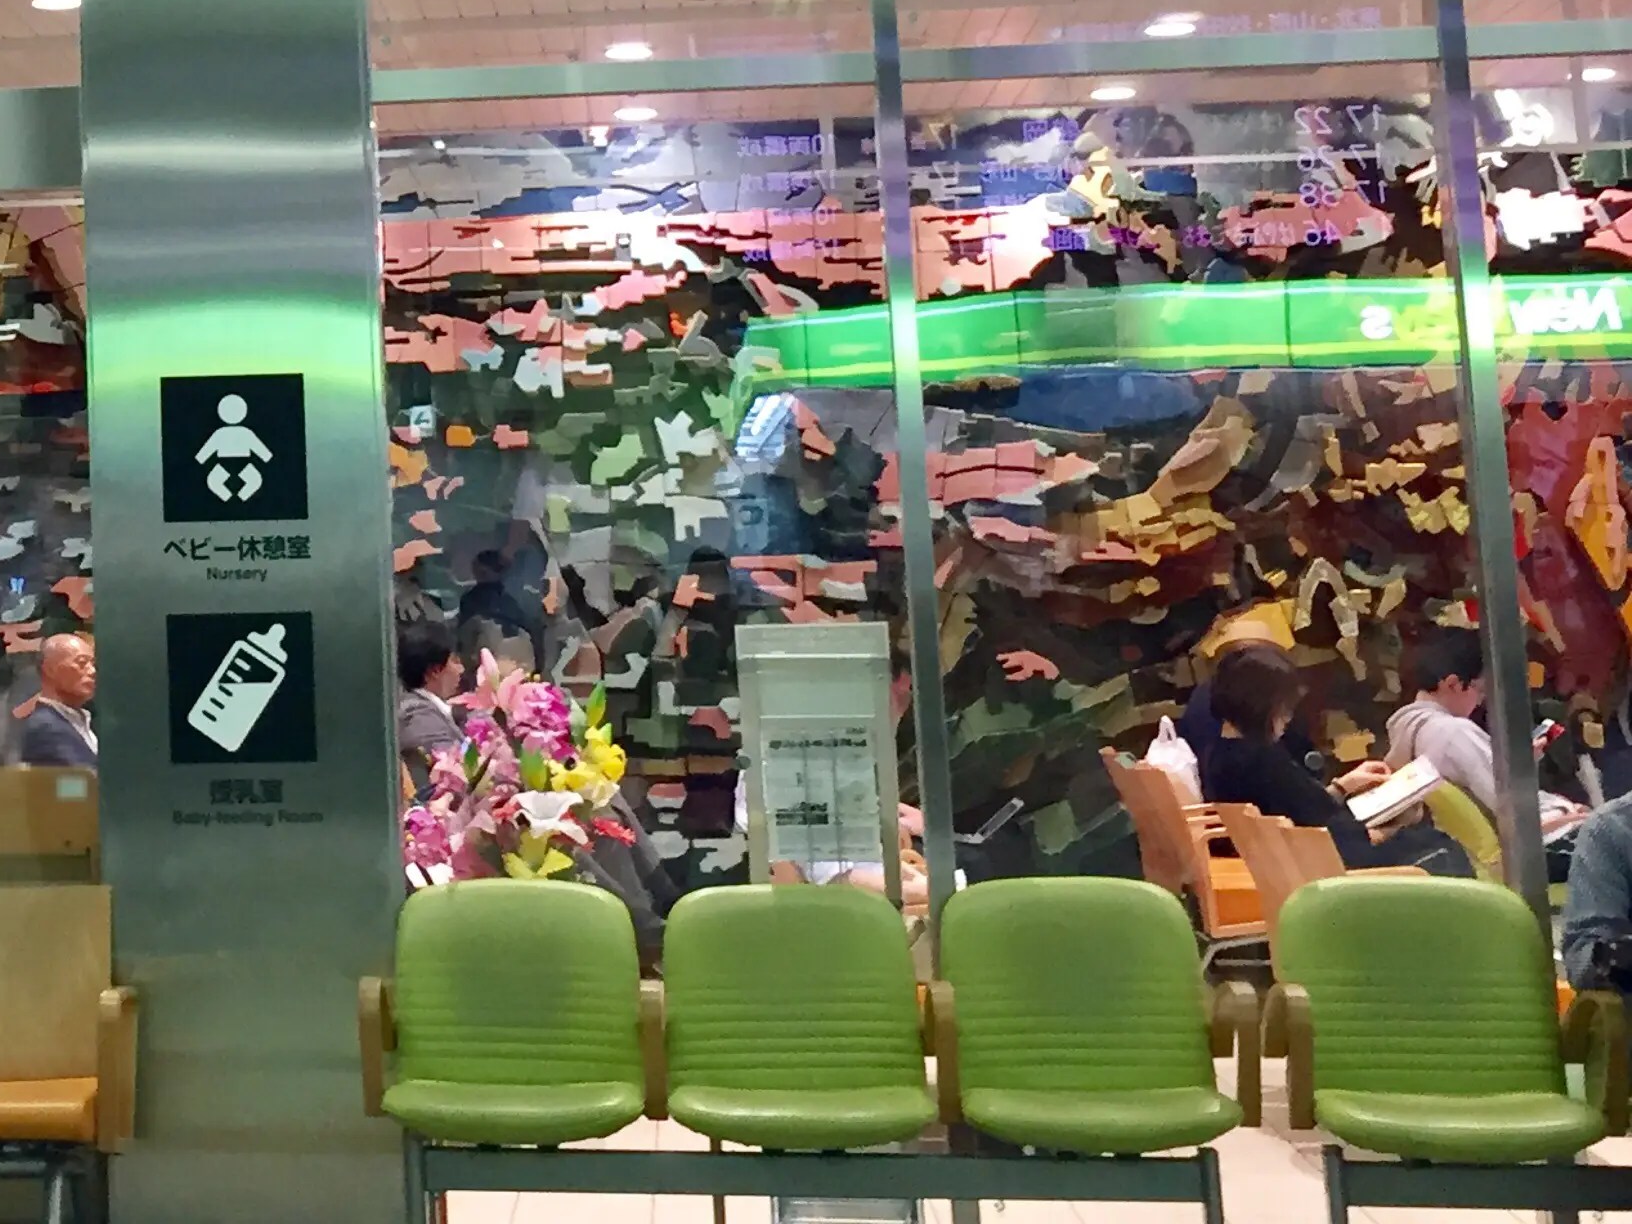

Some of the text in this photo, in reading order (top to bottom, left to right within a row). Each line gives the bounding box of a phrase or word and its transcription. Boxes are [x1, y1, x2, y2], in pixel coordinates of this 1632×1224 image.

[163, 535, 311, 561] ベビー休憩室
[206, 567, 268, 582] Nursery
